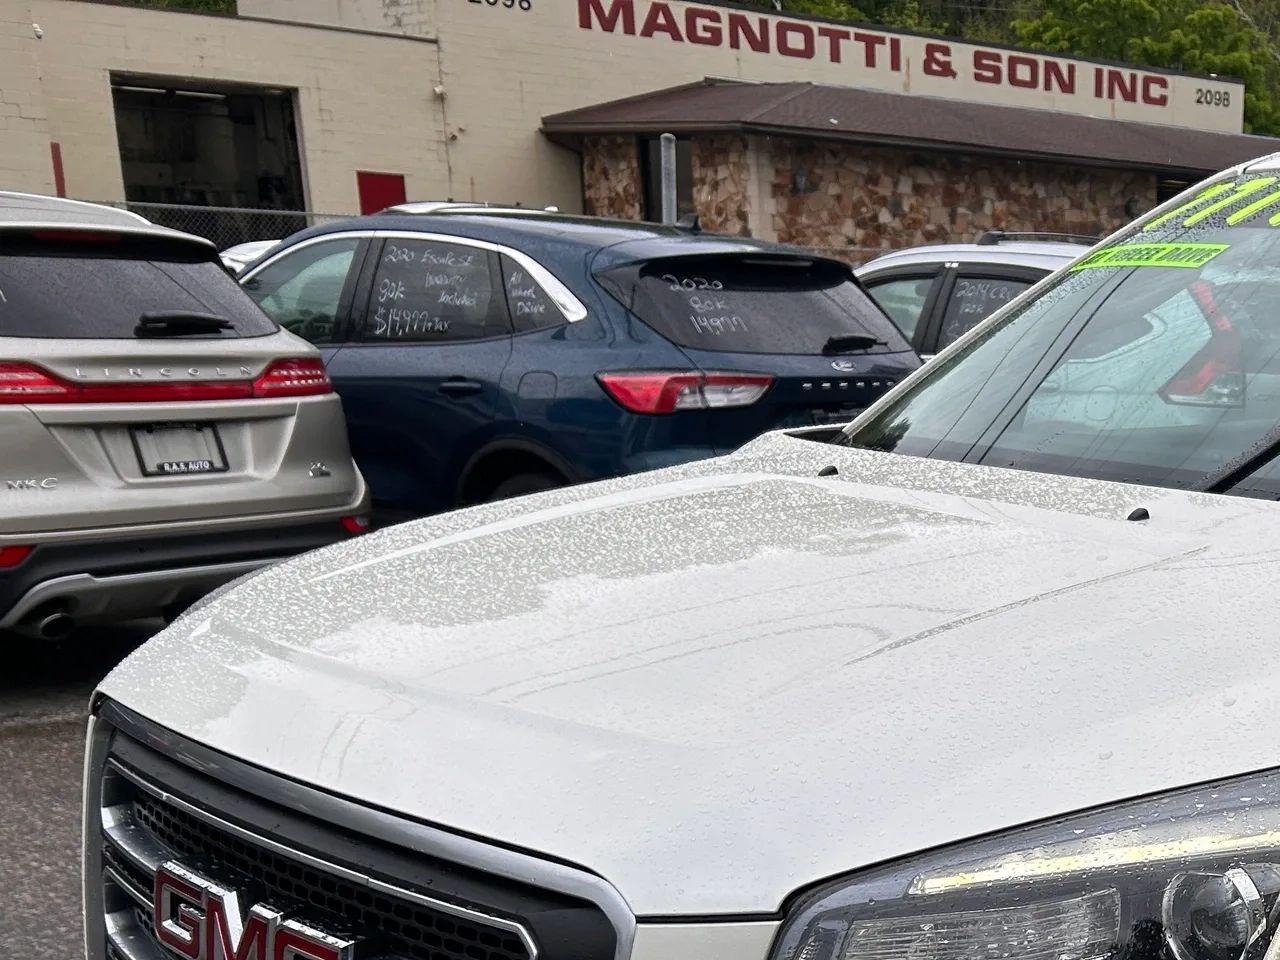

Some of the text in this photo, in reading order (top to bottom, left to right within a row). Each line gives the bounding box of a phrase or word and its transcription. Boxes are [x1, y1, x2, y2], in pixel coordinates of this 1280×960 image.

[578, 0, 1168, 107] MAGNOTTI & SON INC
[1195, 88, 1231, 107] 2098
[661, 273, 723, 291] 2020
[956, 281, 990, 297] 2014
[75, 366, 252, 377] LINCOLN
[188, 461, 210, 471] AUTO
[7, 477, 57, 489] MKC
